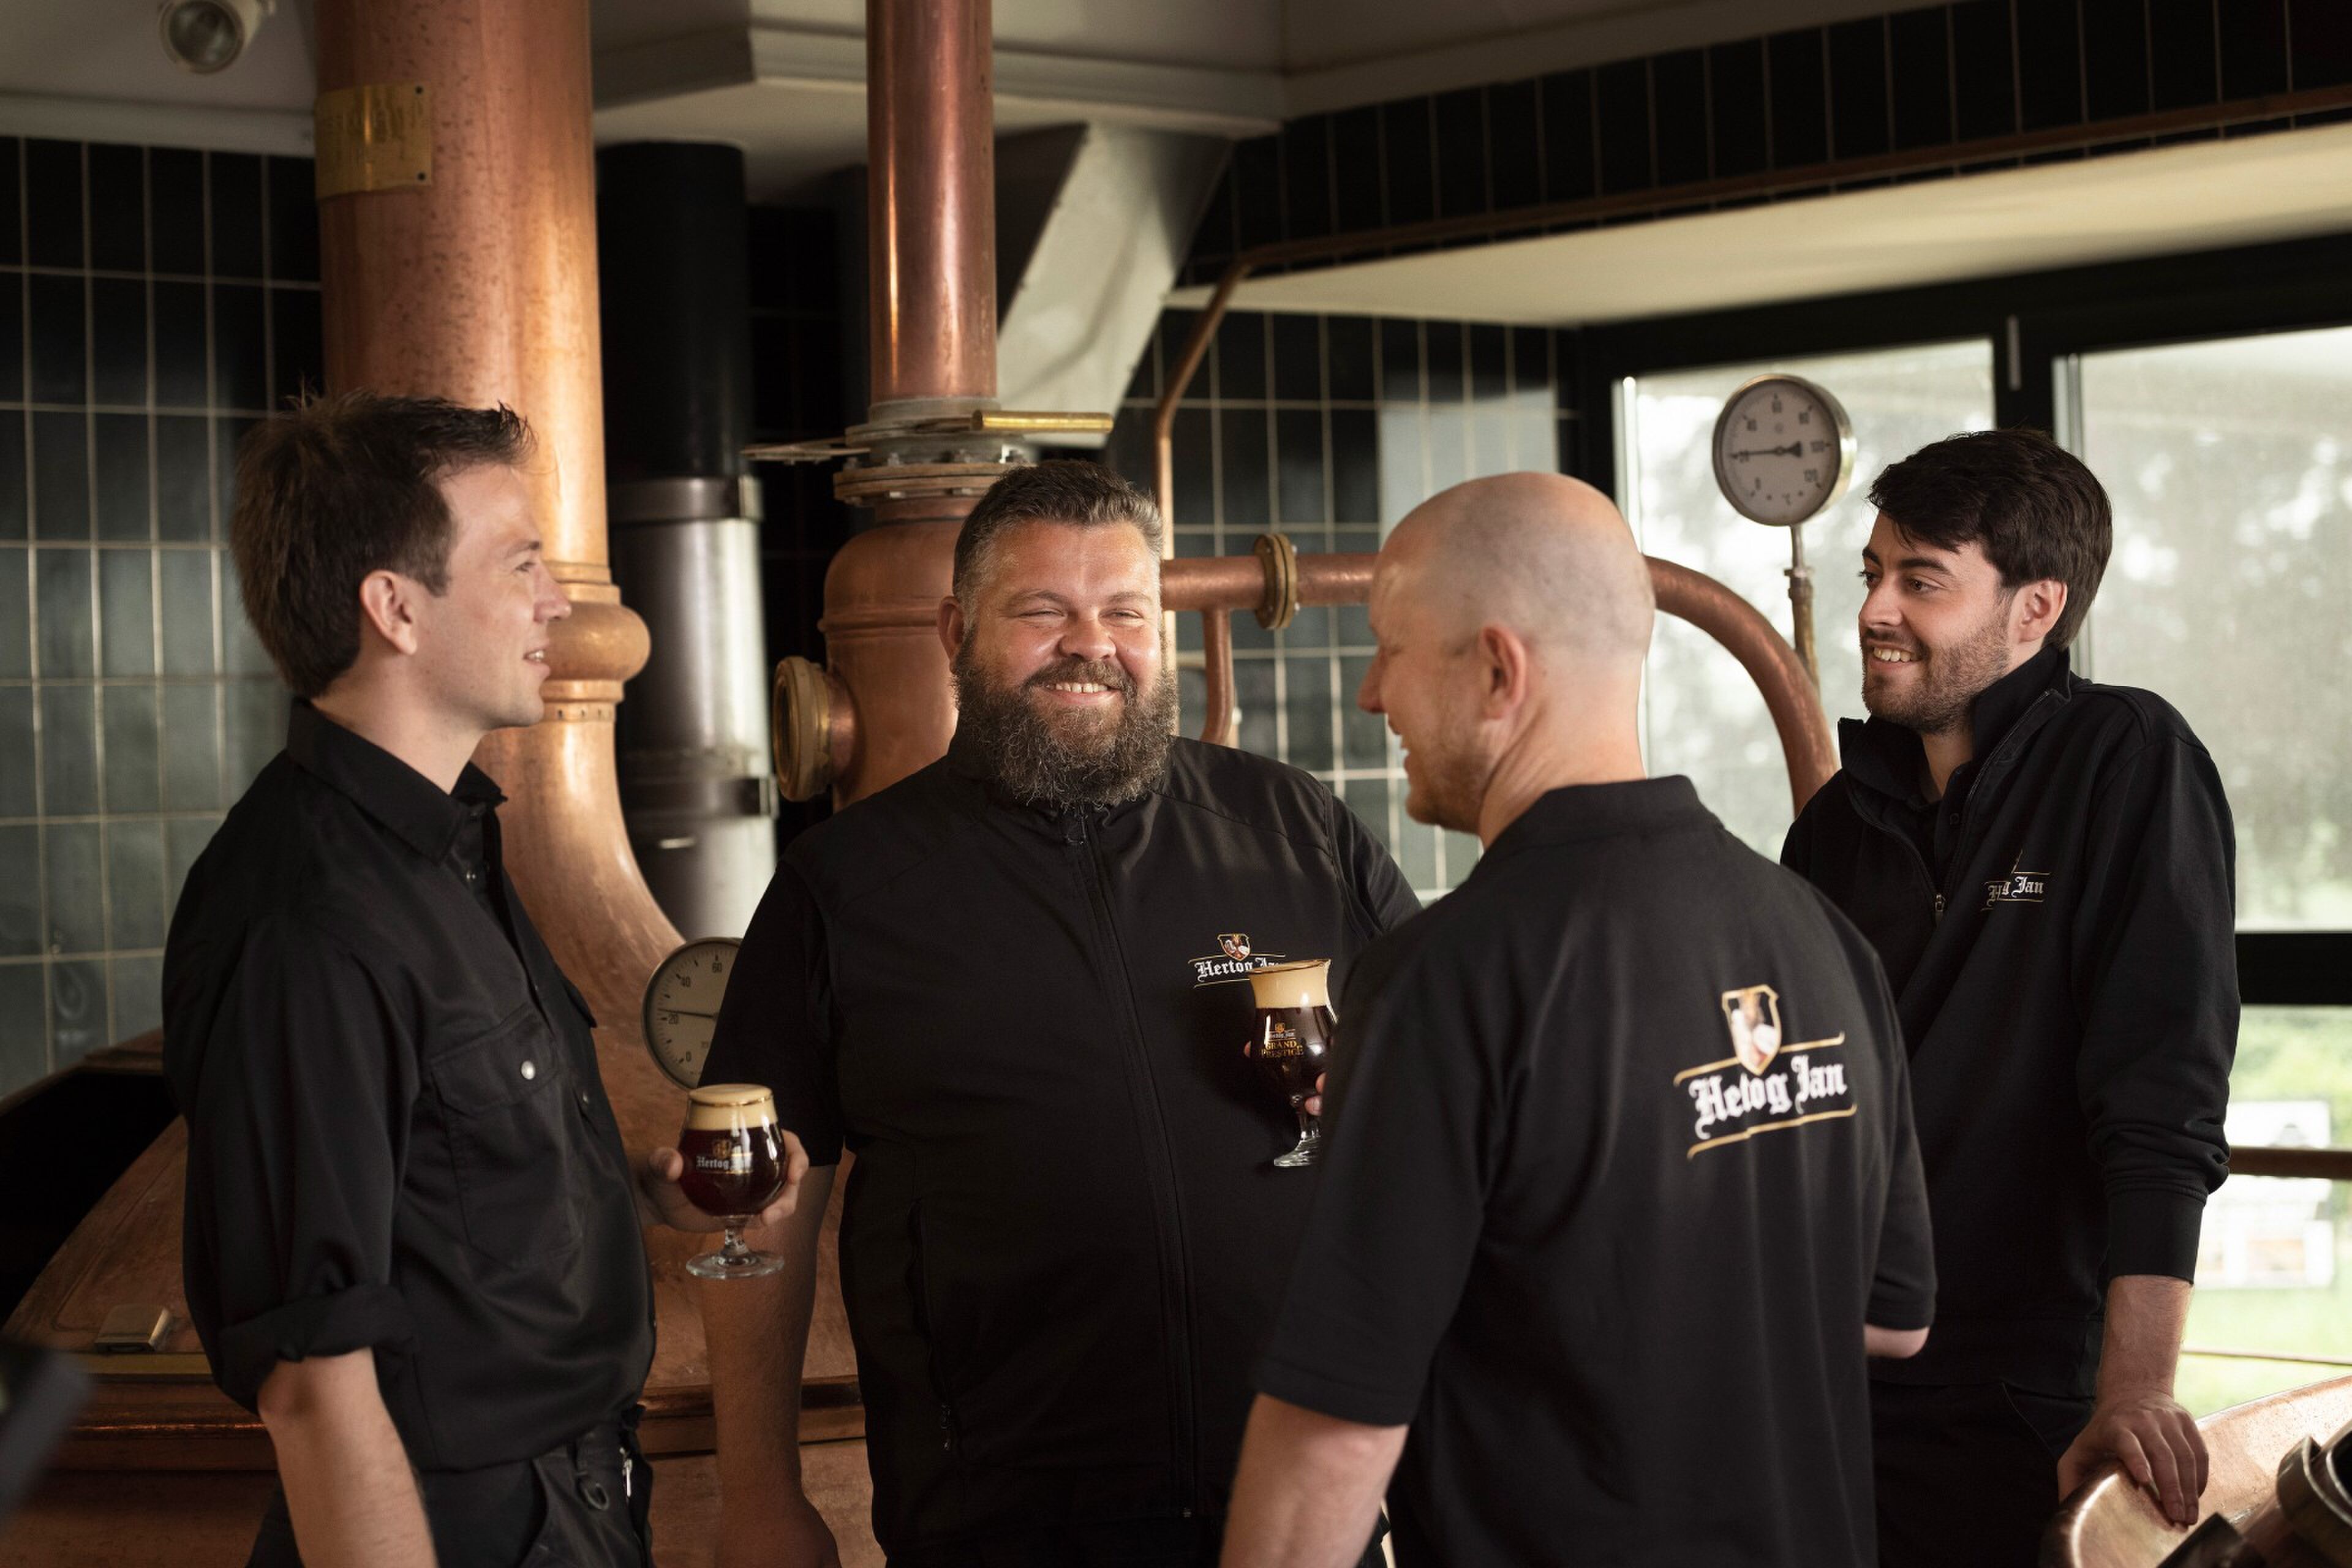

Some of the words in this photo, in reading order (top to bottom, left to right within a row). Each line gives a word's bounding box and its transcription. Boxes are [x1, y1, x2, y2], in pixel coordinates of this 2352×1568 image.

[2011, 876, 2044, 899] Jan
[712, 962, 723, 974] 60
[680, 976, 692, 987] 40
[668, 1014, 679, 1025] 20
[1265, 1040, 1297, 1050] GRAND
[685, 1051, 692, 1063] 0
[1790, 1053, 1848, 1115] Jan
[696, 1155, 729, 1170] Hertog
